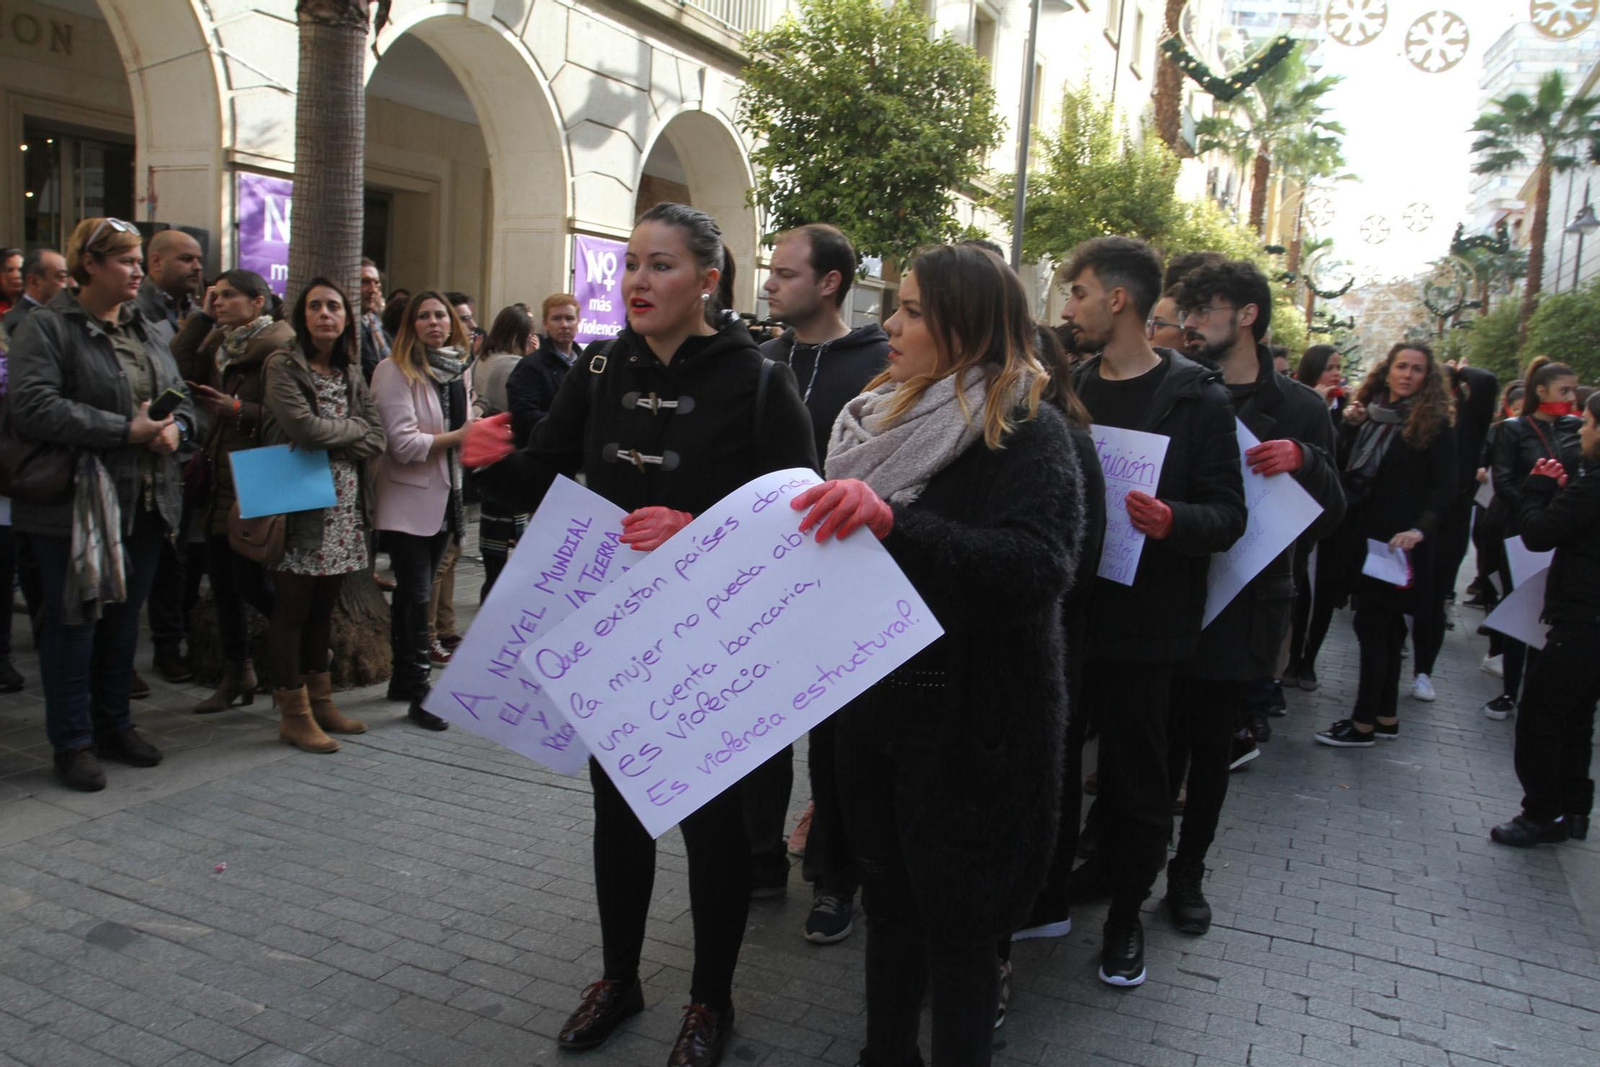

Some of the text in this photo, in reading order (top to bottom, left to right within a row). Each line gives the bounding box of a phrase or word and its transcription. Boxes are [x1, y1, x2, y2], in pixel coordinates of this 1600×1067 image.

[264, 195, 292, 243] N
[589, 295, 613, 312] más
[1095, 437, 1156, 484] trición
[450, 517, 593, 721] A NIVEL MUNDIAL
[498, 701, 531, 727] EL
[577, 530, 622, 583] TIERRA
[535, 640, 593, 680] Que
[594, 576, 669, 638] existan
[674, 516, 740, 582] países
[570, 692, 604, 719] la
[608, 638, 664, 692] mujer
[672, 613, 700, 639] no
[706, 563, 768, 619] pueda
[530, 710, 550, 731] Y
[598, 722, 641, 751] una
[719, 579, 821, 656] bancaria,
[646, 778, 690, 807] Es
[696, 713, 787, 776] violencia
